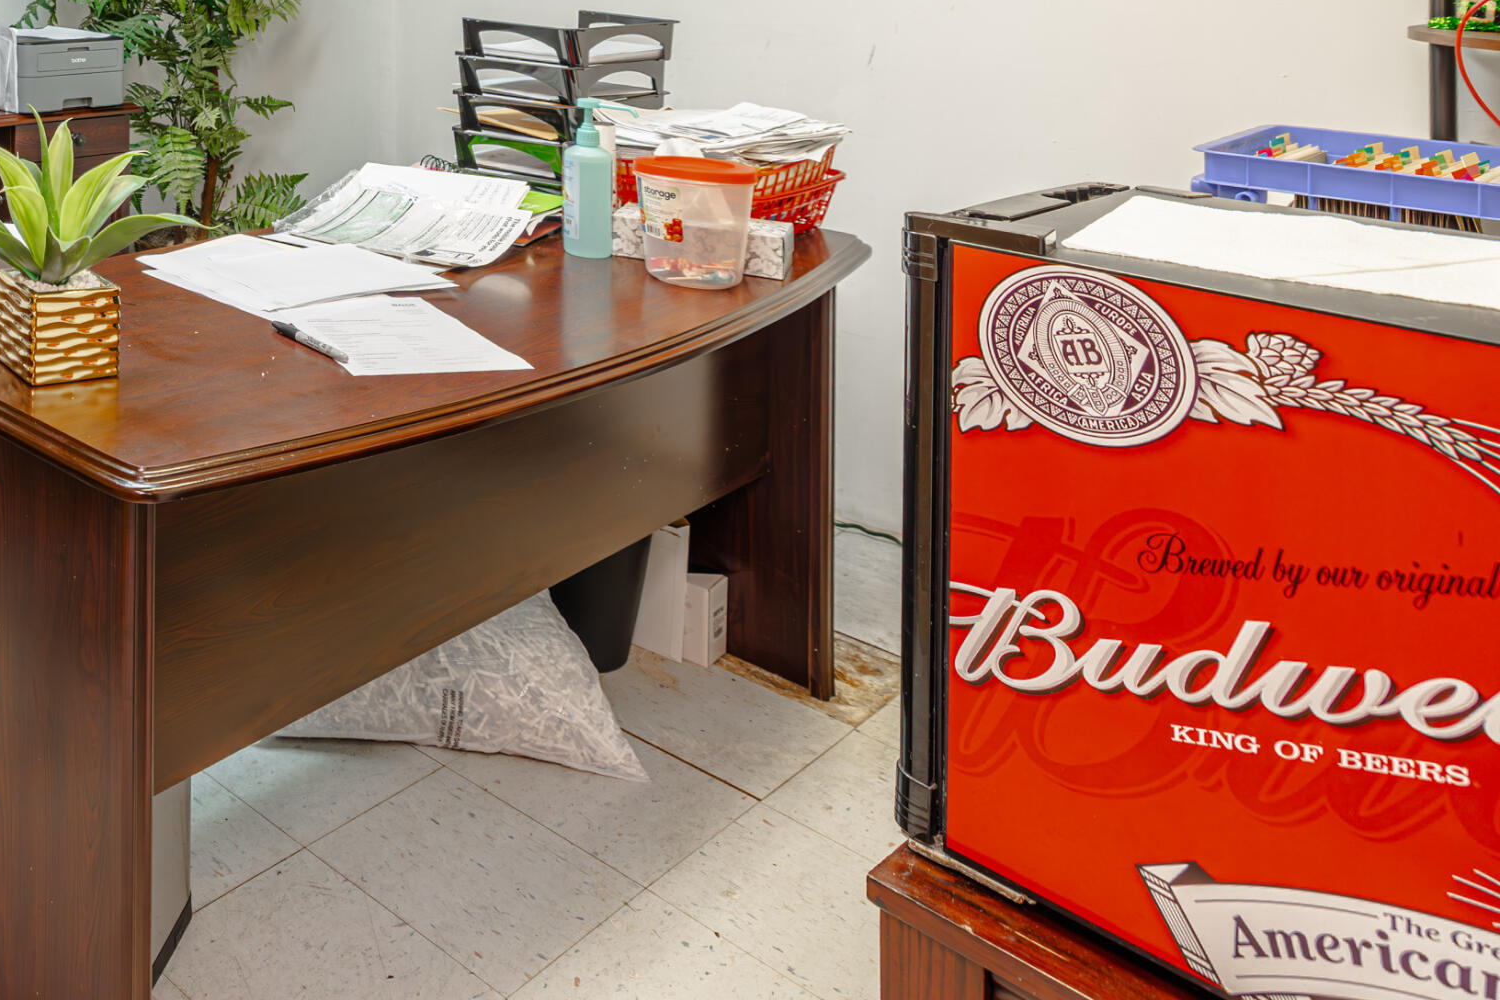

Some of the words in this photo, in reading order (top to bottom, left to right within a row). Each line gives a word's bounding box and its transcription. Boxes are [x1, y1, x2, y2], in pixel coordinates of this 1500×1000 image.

[644, 186, 676, 200] storage
[1014, 306, 1037, 346] AUSTRALIA
[1094, 303, 1138, 337] EUROPE
[1060, 338, 1103, 366] AB
[1028, 371, 1069, 406] AFRICA
[1130, 371, 1155, 402] ASIA
[1081, 417, 1138, 430] AMERICA
[1137, 532, 1265, 581] Brewed
[1272, 548, 1307, 599] by
[1316, 564, 1368, 589] our
[1376, 561, 1500, 610] original
[950, 580, 1500, 745] Budwe
[1170, 723, 1261, 755] KING
[1273, 739, 1324, 763] OF
[1337, 748, 1471, 787] BEERS
[1383, 911, 1441, 942] The
